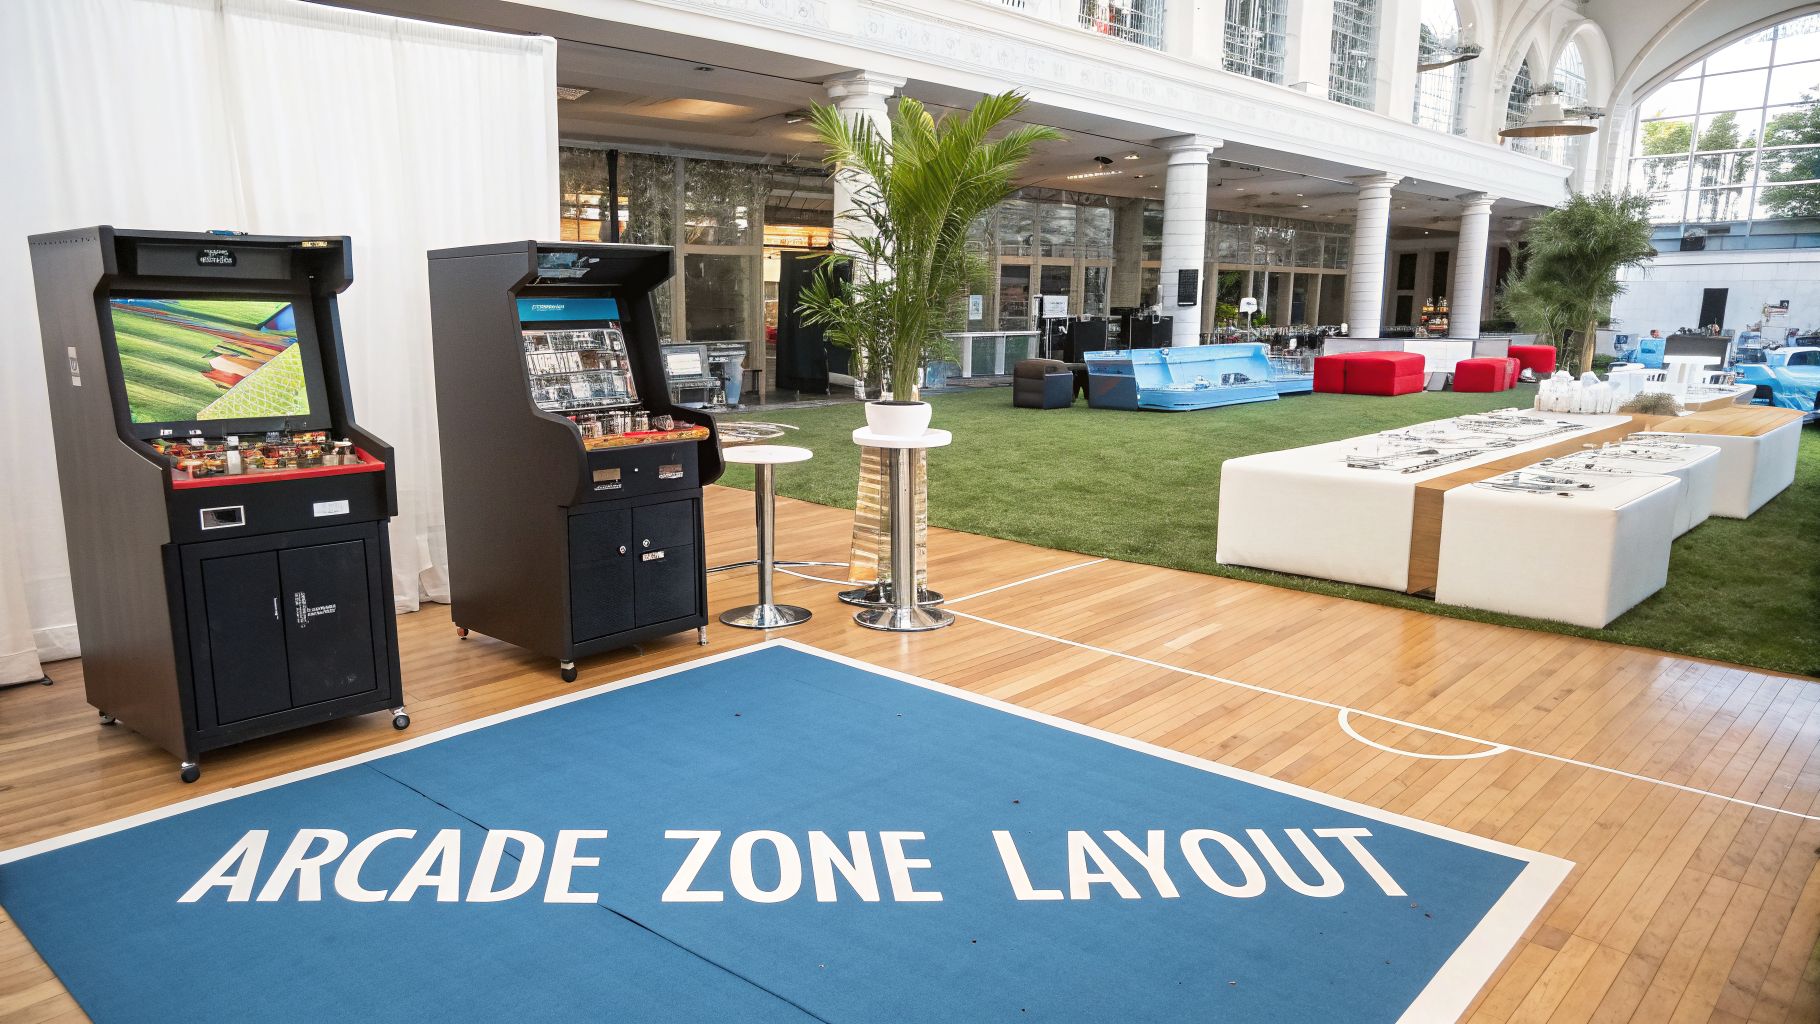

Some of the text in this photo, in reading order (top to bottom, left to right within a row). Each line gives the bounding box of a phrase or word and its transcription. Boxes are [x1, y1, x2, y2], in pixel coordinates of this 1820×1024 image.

[177, 828, 1408, 903] ARCADE ZONE LAYOUT
